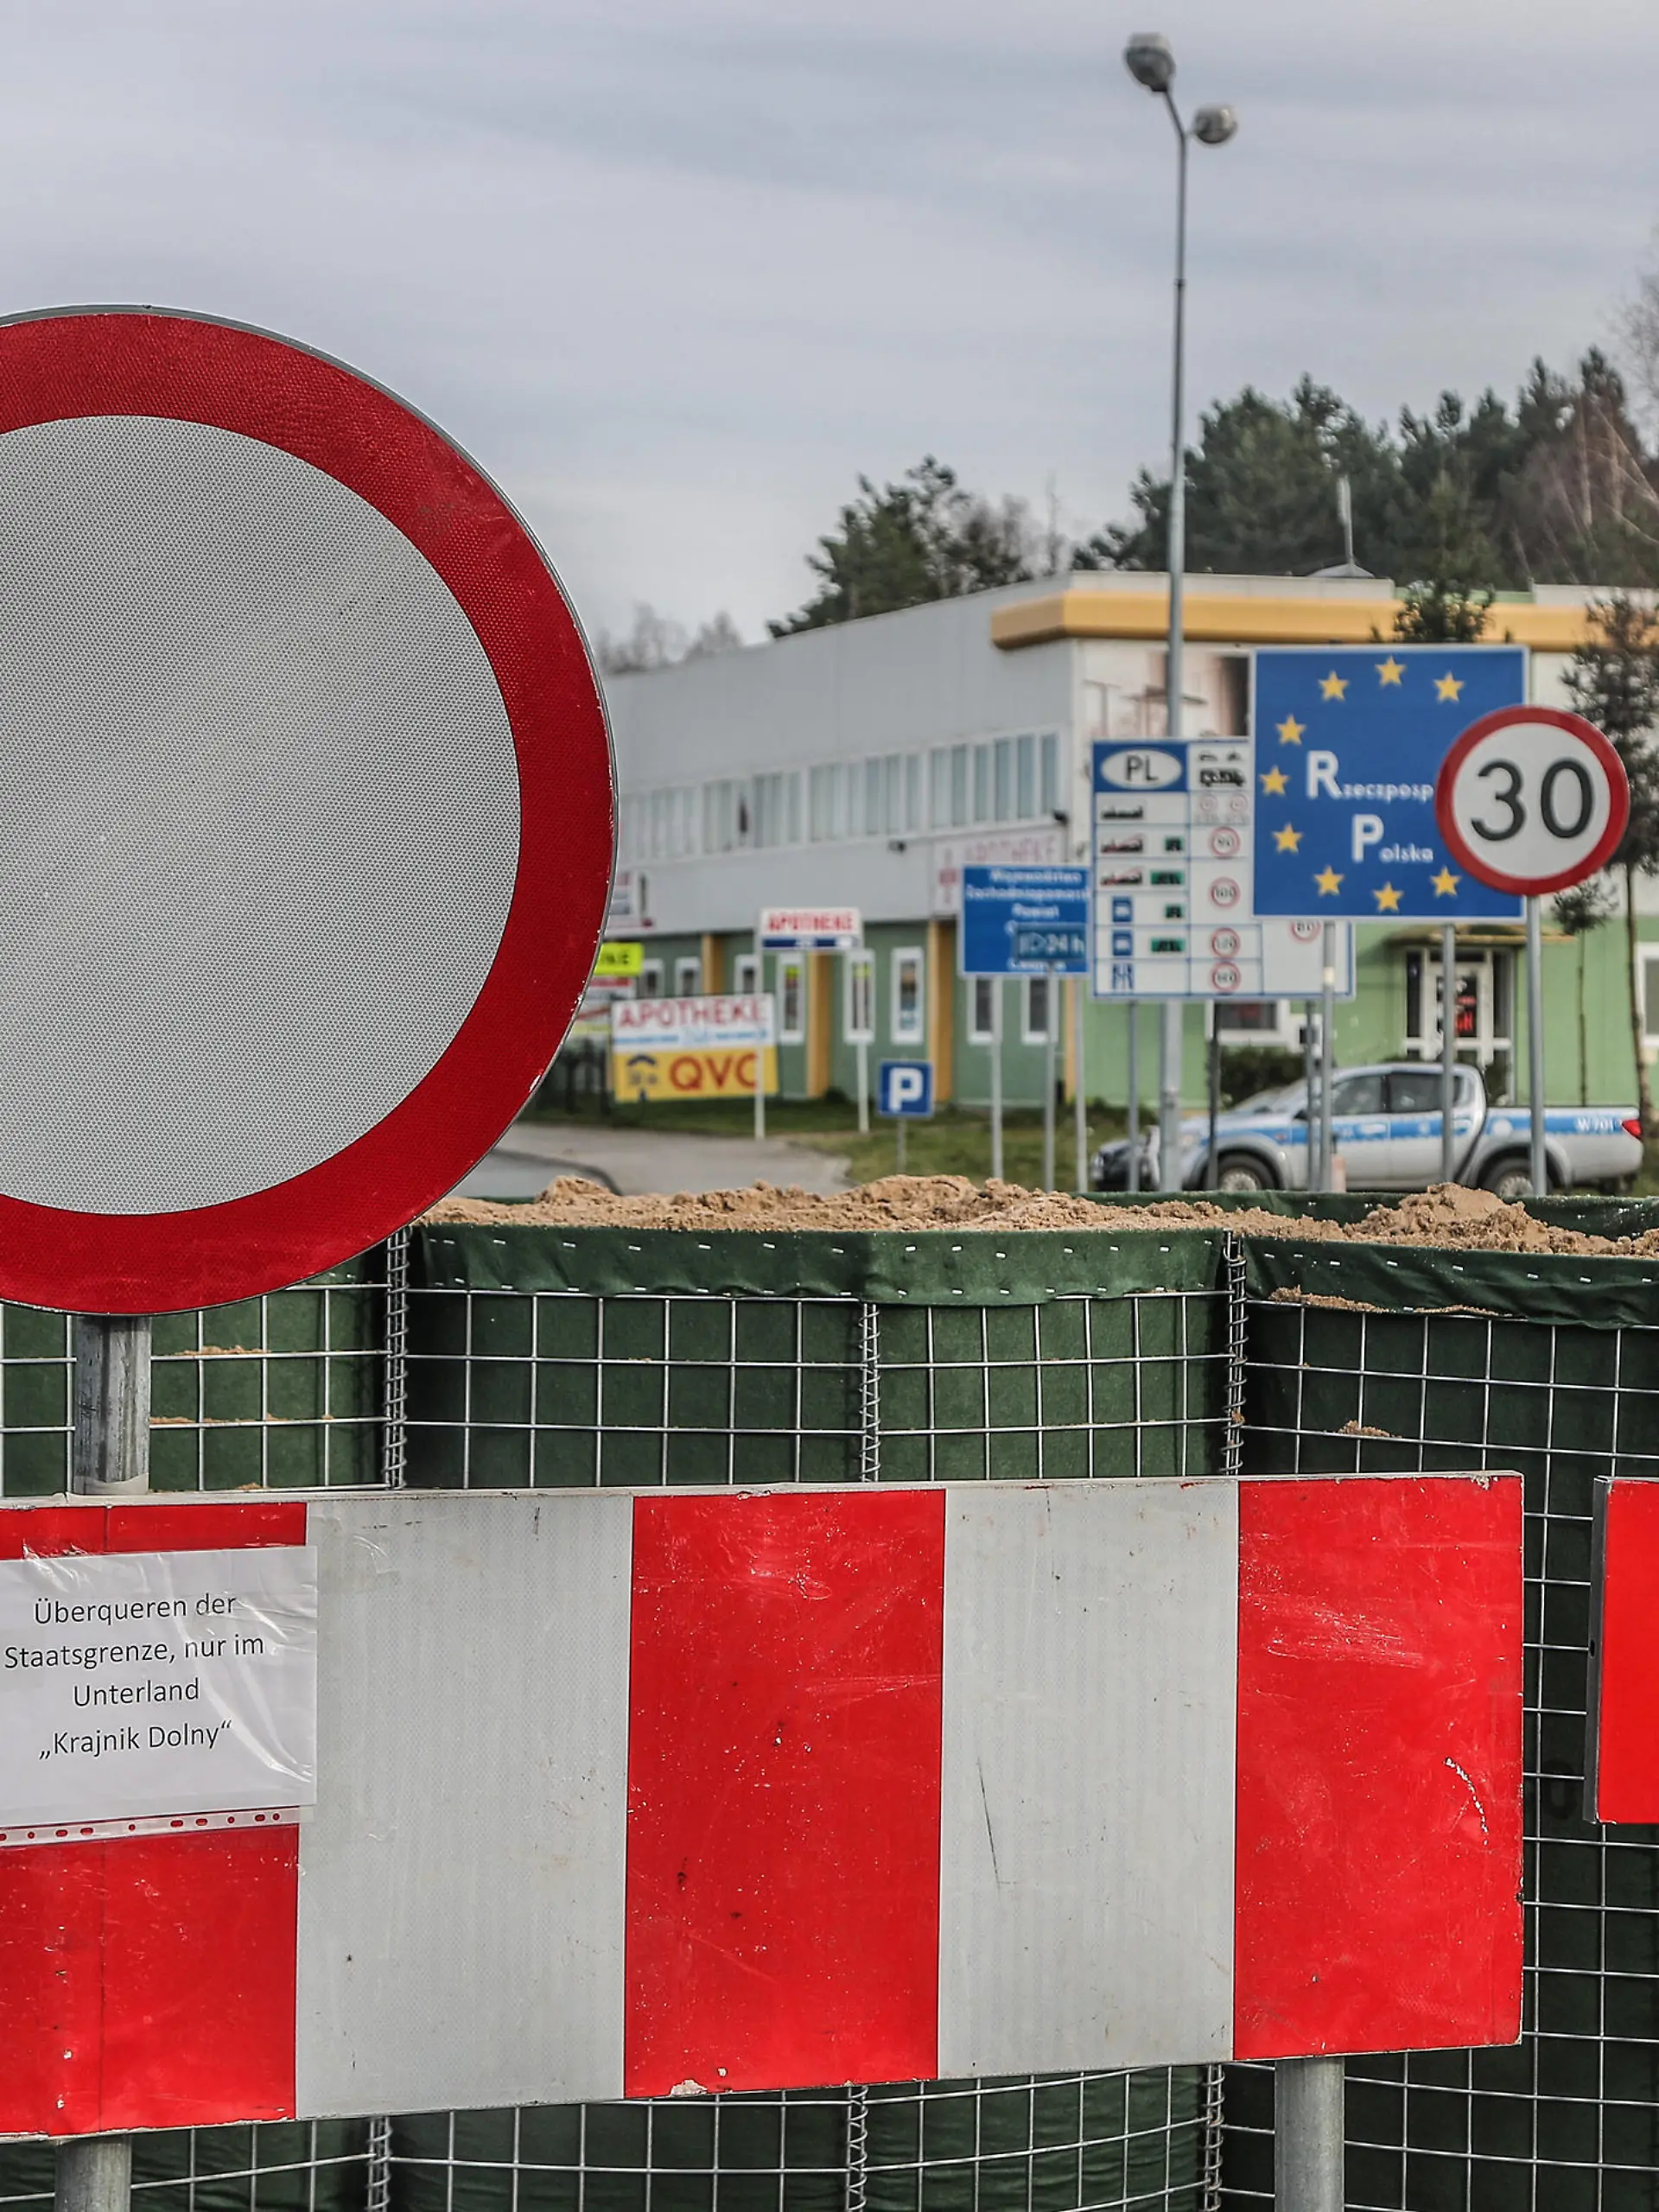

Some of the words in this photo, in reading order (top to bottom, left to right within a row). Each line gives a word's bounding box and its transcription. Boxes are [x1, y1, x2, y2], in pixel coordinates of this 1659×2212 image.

[1125, 755, 1159, 781] PL
[1306, 750, 1434, 804] Rzeczposp
[1471, 759, 1594, 841] 30
[1351, 813, 1433, 862] Polska
[767, 912, 854, 931] APOTHEKE
[619, 998, 768, 1028] APOTHEKE
[669, 1052, 758, 1091] QVC
[889, 1067, 924, 1112] P
[35, 1598, 187, 1625] Überqueren
[196, 1593, 237, 1615] der
[4, 1642, 175, 1669] Staatsgrenze,
[184, 1638, 226, 1659] nur
[234, 1634, 264, 1656] im
[73, 1678, 200, 1707] Unterland
[39, 1726, 140, 1760] „Krajnik
[149, 1720, 232, 1748] Dolny“
